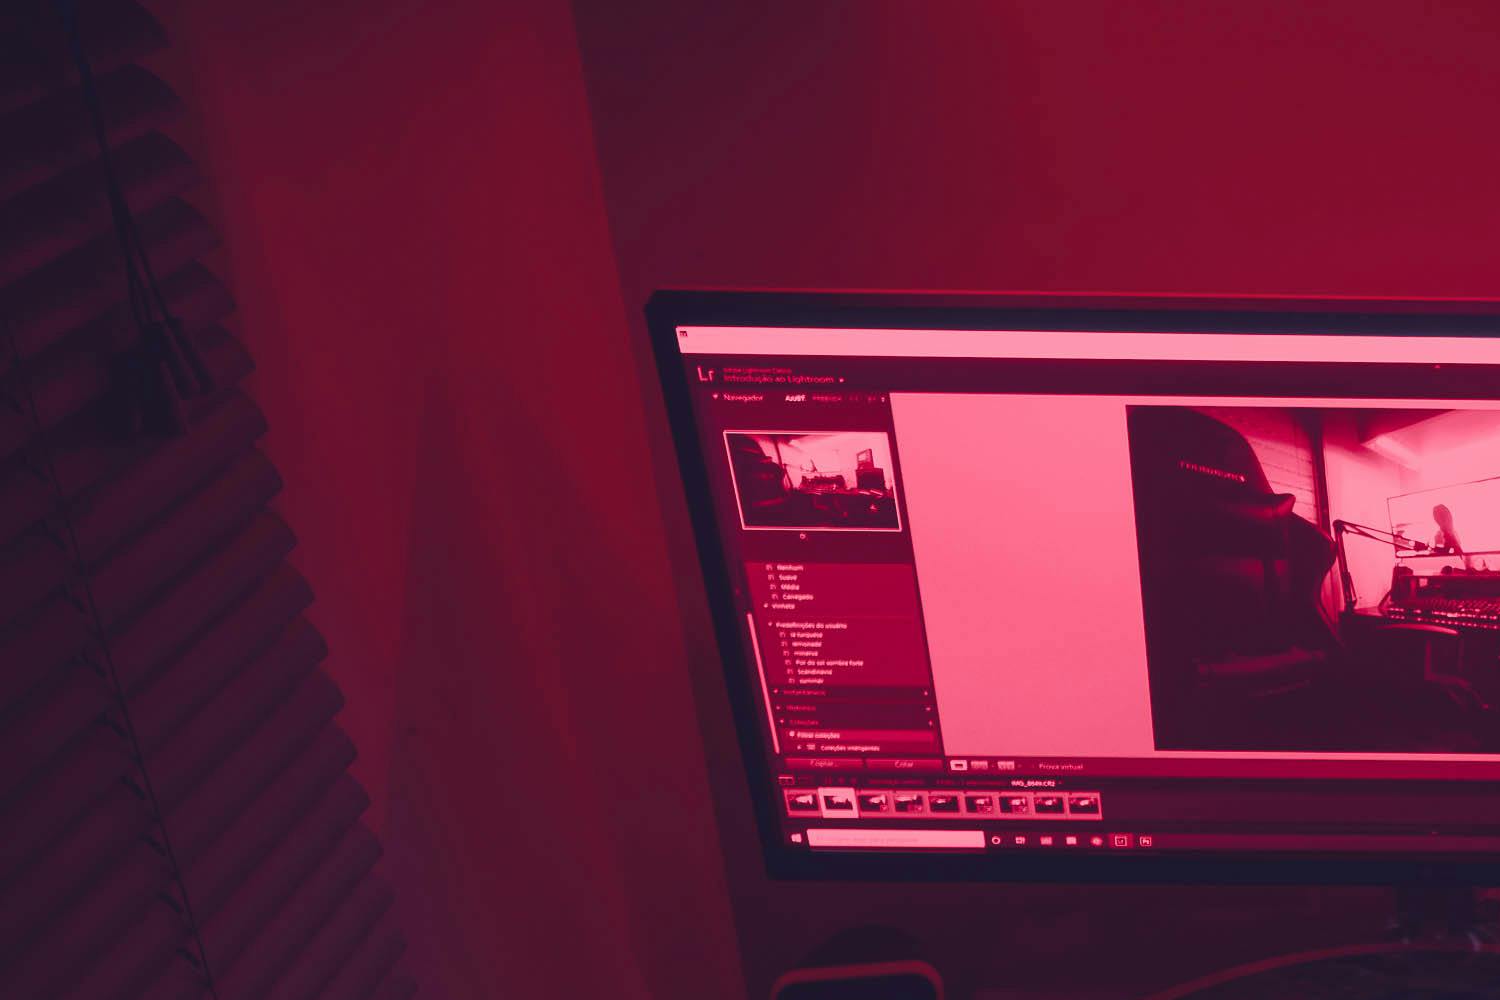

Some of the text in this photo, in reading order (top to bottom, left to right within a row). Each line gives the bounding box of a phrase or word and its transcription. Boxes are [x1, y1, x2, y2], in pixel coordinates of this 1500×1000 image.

[697, 366, 715, 382] Lr
[724, 375, 834, 384] Introdução ao Lightroom
[724, 394, 763, 402] Navegador
